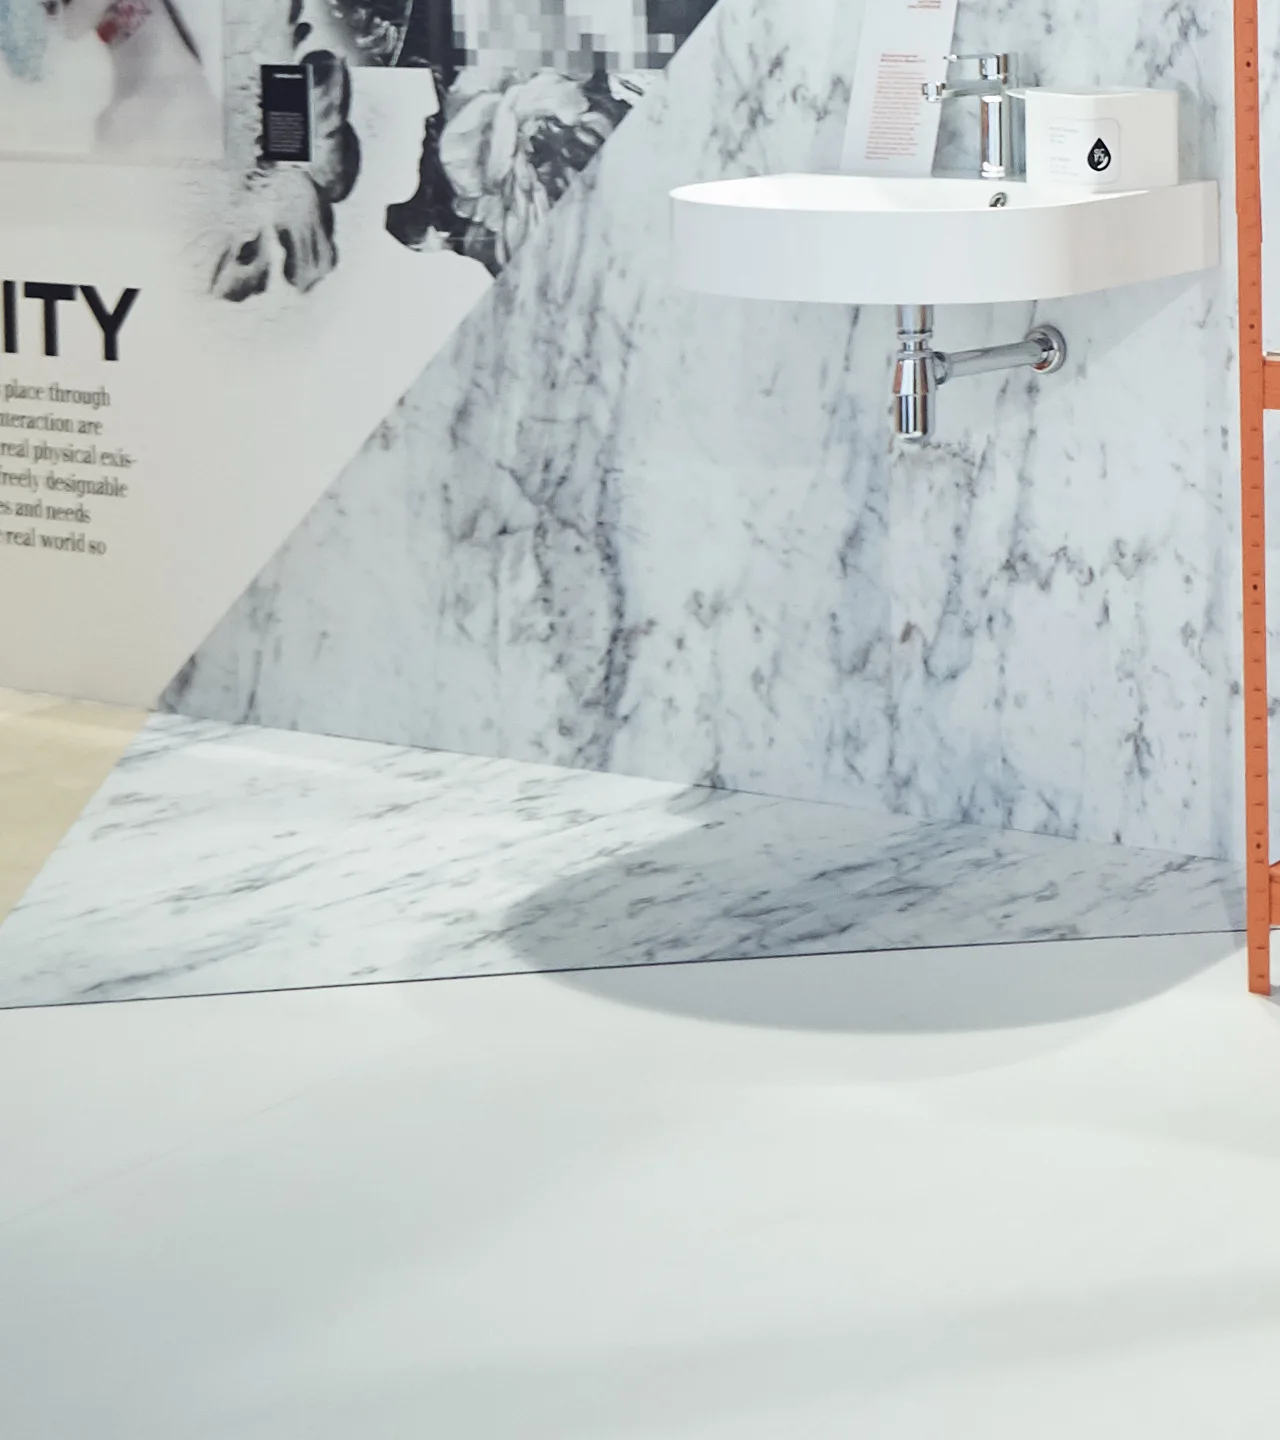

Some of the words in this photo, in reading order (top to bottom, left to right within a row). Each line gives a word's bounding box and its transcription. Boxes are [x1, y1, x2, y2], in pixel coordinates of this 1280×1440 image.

[3, 280, 141, 361] ITY
[5, 378, 45, 403] place
[49, 381, 111, 411] through
[77, 419, 104, 435] are
[1, 438, 30, 459] real
[33, 440, 97, 466] physical
[45, 470, 130, 499] designable
[15, 498, 43, 519] and
[46, 502, 92, 524] needs
[6, 527, 36, 548] real
[40, 531, 87, 554] world
[88, 539, 109, 557] so
